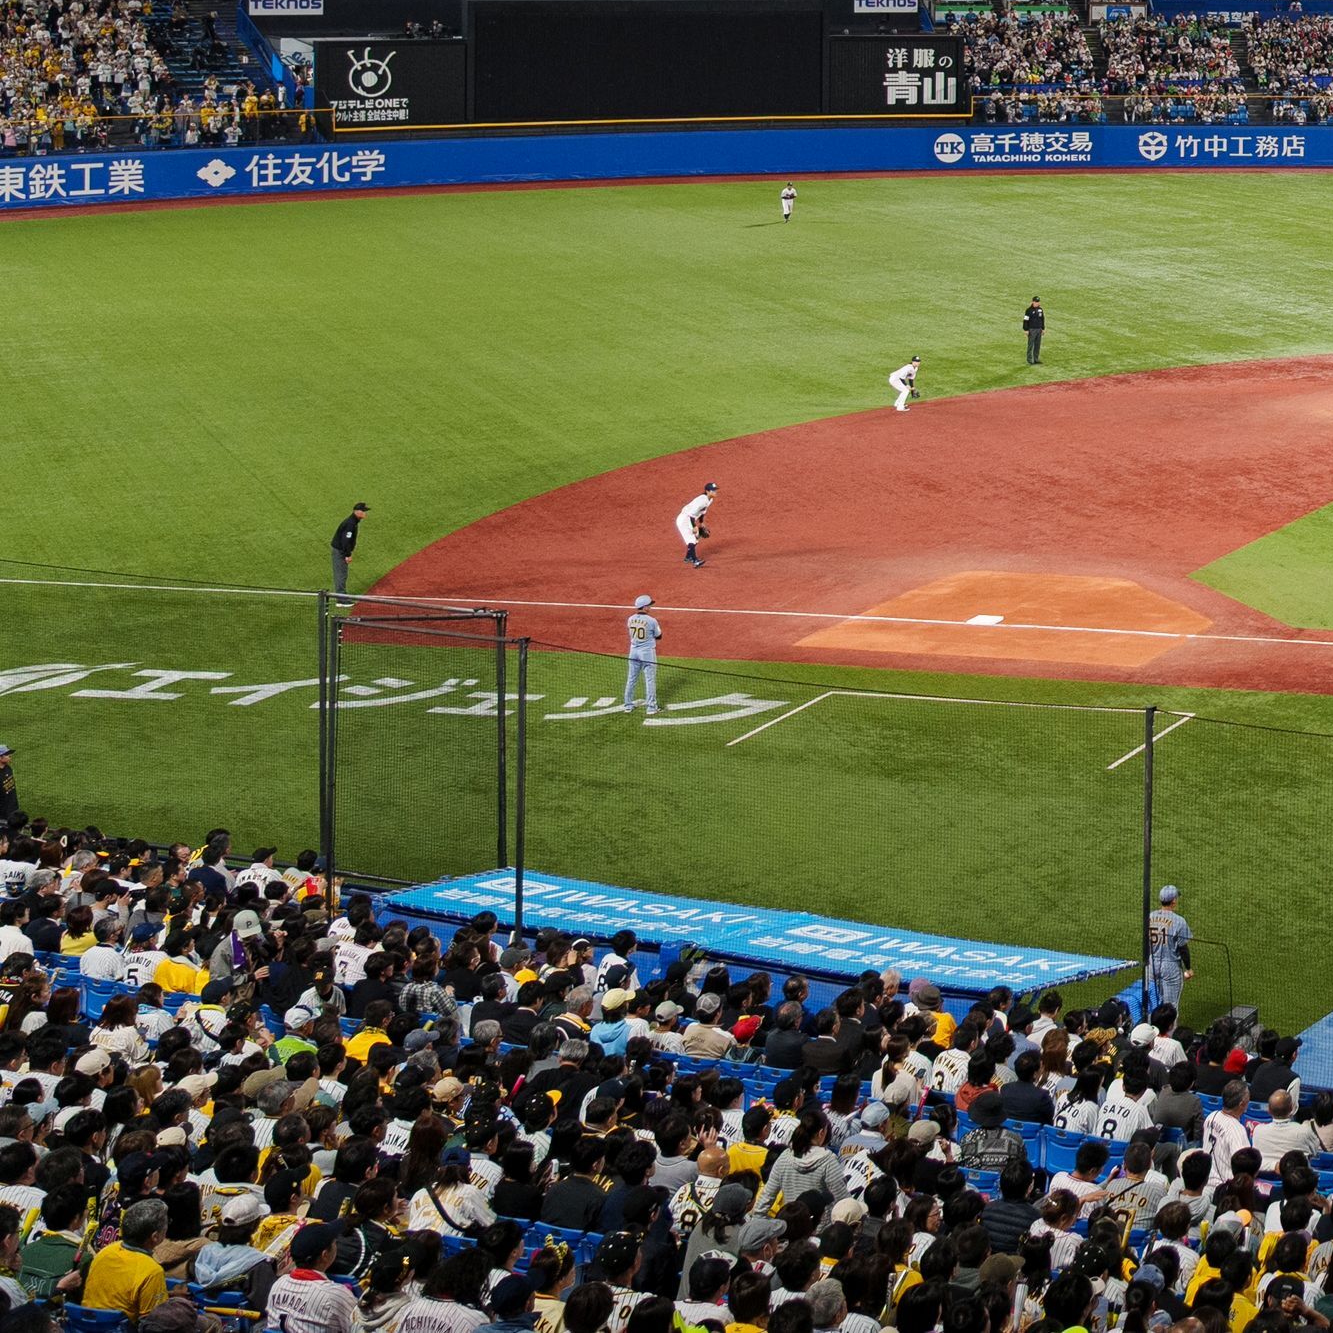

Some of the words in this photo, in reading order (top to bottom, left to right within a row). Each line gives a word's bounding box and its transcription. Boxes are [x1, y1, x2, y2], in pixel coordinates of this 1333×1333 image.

[886, 47, 954, 68] 洋服の
[884, 71, 957, 106] 青山
[329, 98, 409, 109] フジテレビONEで
[333, 110, 366, 122] クルト主催
[970, 131, 1093, 154] 高千穂交易
[1175, 135, 1305, 159] 竹中工務店
[245, 150, 386, 187] 住友化学
[973, 154, 1041, 162] TAKACHIHO
[1045, 154, 1091, 162] KOHEKI
[0, 158, 145, 201] 東鉄工業
[630, 626, 646, 642] 70
[543, 888, 758, 925] IWASAKI
[864, 936, 1085, 972] IWASAKI
[1102, 1100, 1131, 1120] SATO
[271, 1294, 308, 1314] YAMADA
